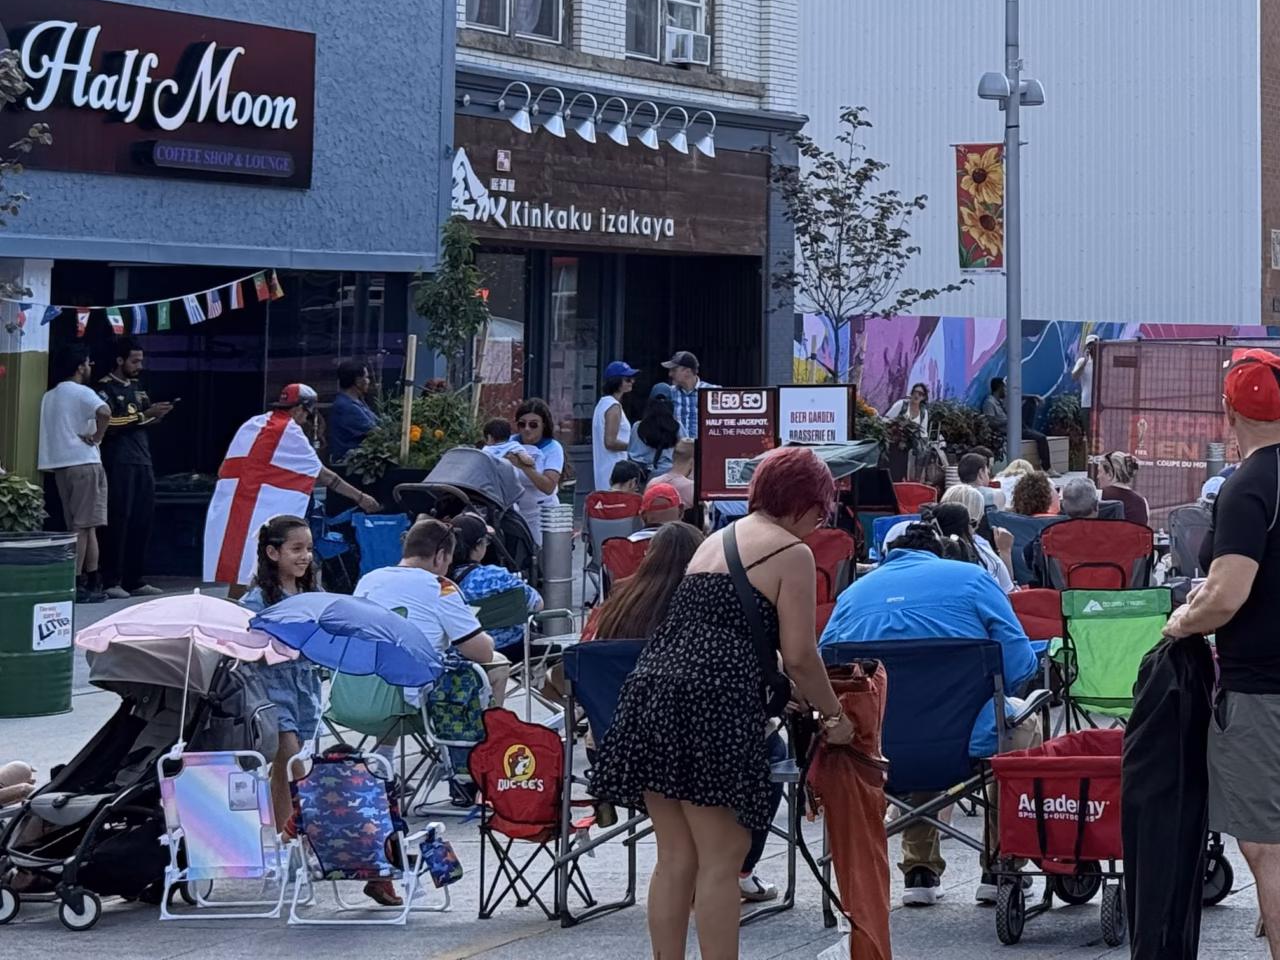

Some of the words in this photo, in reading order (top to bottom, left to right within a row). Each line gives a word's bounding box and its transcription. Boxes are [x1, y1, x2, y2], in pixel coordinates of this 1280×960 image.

[21, 20, 159, 123] Half
[153, 41, 298, 131] Moon
[156, 145, 202, 163] COFFEE
[203, 149, 234, 166] SHOP
[245, 153, 291, 171] LOUNGE
[510, 200, 592, 232] Kinkaku
[601, 207, 675, 241] izakaya
[705, 418, 723, 426] HALF
[723, 418, 736, 426] THE
[790, 411, 807, 424] BEER
[808, 411, 835, 424] GARDEN
[708, 428, 722, 436] ALL
[722, 428, 735, 436] THE
[789, 429, 825, 442] BRASSERIE
[827, 429, 836, 441] EN
[1157, 441, 1199, 460] EN
[1156, 460, 1180, 468] COUPE
[1181, 460, 1192, 468] DU
